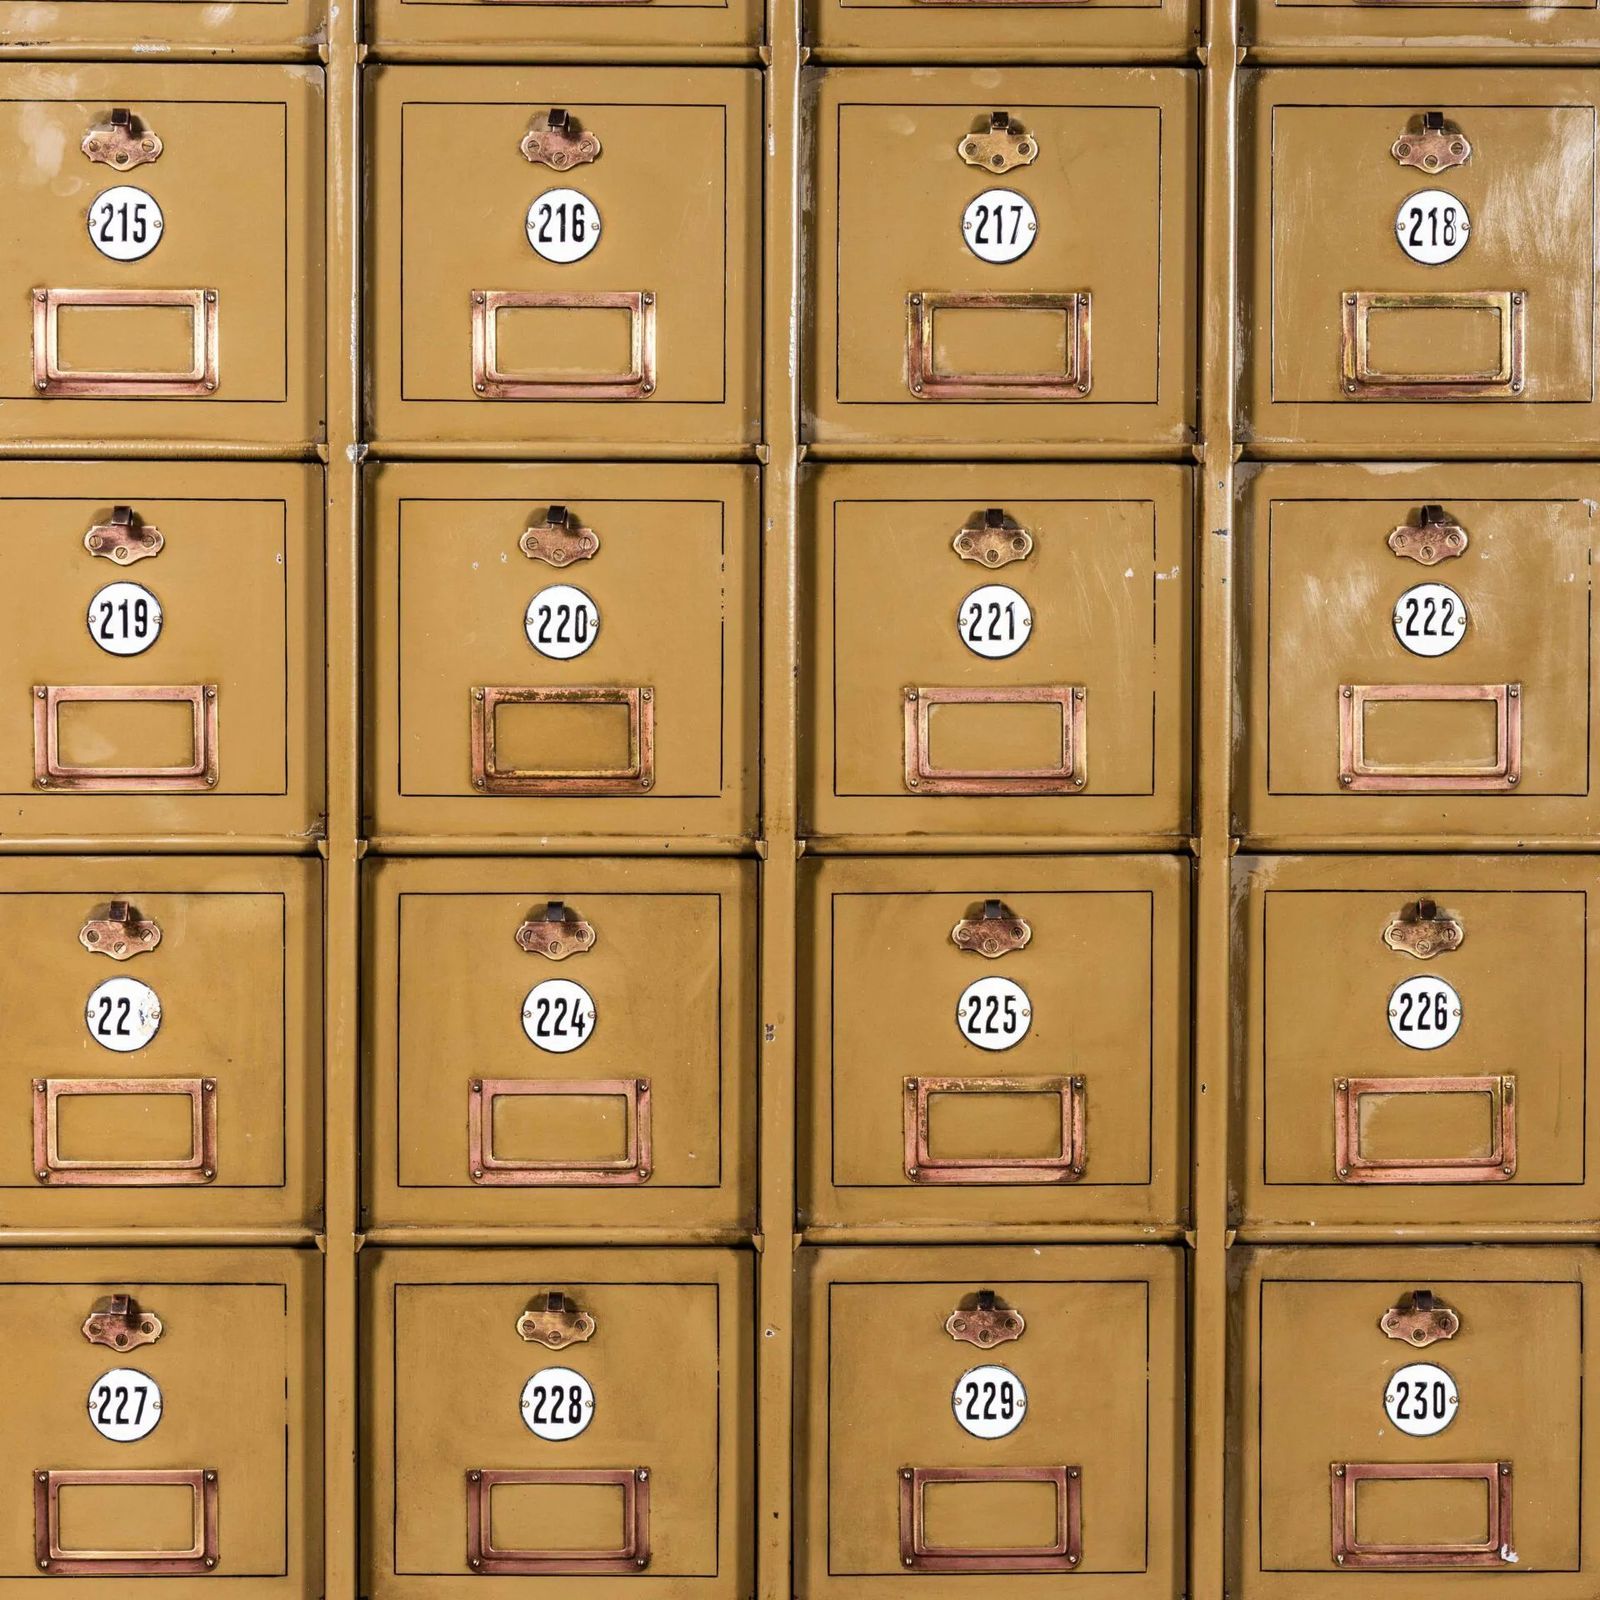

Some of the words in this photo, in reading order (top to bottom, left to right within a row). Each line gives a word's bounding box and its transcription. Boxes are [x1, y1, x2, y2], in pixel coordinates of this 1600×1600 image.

[101, 203, 146, 242] 215
[539, 204, 584, 242] 216
[976, 206, 1023, 244] 217
[1410, 208, 1456, 246] 218
[101, 599, 147, 639] 219
[539, 605, 587, 643] 220
[968, 602, 1014, 641] 221
[1406, 598, 1454, 636] 222
[98, 996, 145, 1035] 22
[537, 998, 586, 1038] 224
[968, 996, 1016, 1034] 225
[1400, 992, 1447, 1031] 226
[98, 1386, 147, 1424] 227
[533, 1386, 581, 1424] 228
[966, 1382, 1014, 1420] 229
[1397, 1382, 1445, 1420] 230
